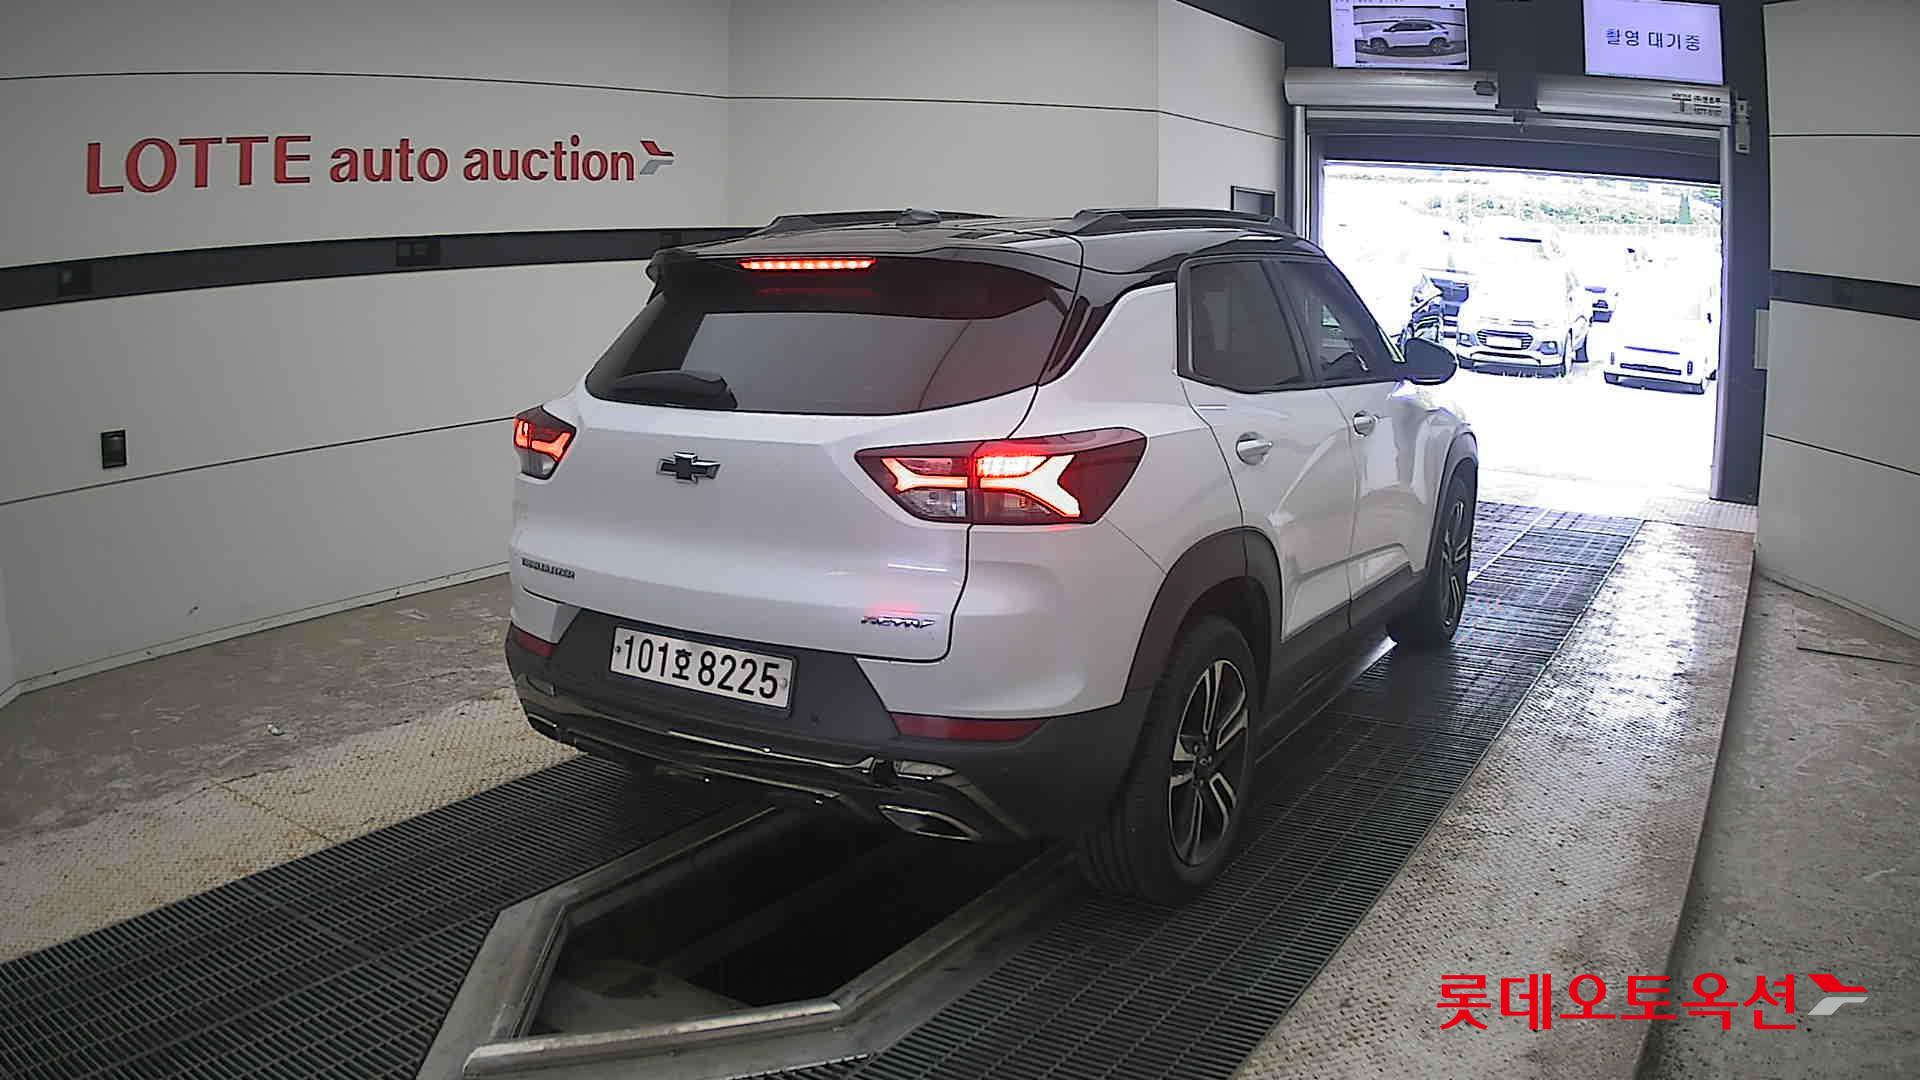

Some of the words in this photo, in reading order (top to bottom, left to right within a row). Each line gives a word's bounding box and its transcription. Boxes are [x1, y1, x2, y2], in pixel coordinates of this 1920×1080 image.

[1648, 31, 1701, 51] 대기중
[86, 136, 311, 194] LOTTE
[329, 139, 448, 183] auto
[463, 135, 635, 182] auction
